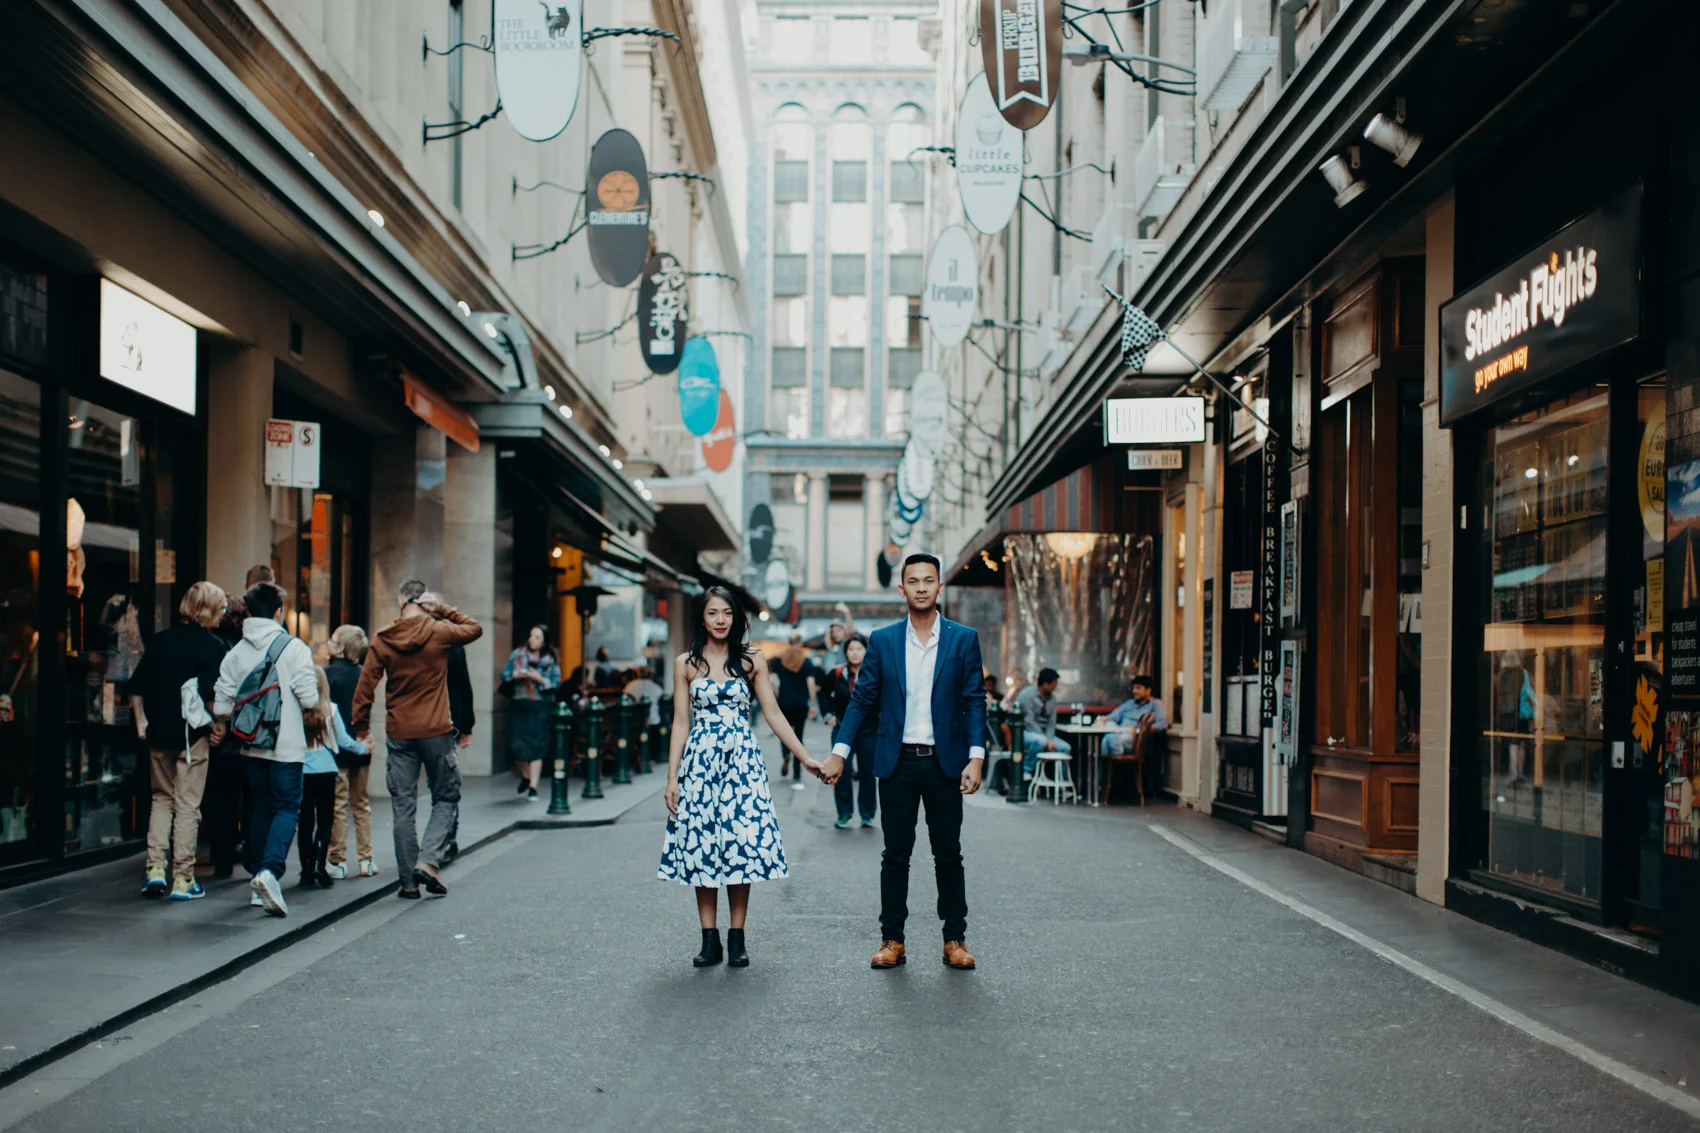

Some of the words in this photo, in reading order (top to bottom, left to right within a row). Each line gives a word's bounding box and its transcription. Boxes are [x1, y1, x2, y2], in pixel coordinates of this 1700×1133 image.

[500, 19, 524, 29] THE
[500, 30, 541, 40] LITTLE
[1018, 0, 1040, 82] BURGE
[500, 40, 575, 51] BOOKROOM
[960, 164, 1020, 174] CUPCAKES
[1465, 280, 1528, 361] Student
[1530, 247, 1598, 328] Flights
[1475, 370, 1483, 394] go
[1483, 361, 1499, 390] your
[1499, 354, 1513, 377] own
[1513, 345, 1528, 371] way
[269, 432, 292, 441] ZONE
[1265, 440, 1276, 513] COFFEE
[1652, 485, 1665, 501] SAL
[1265, 527, 1275, 636] BREAKFAST
[1685, 618, 1697, 631] travel
[1671, 655, 1696, 669] backpackers
